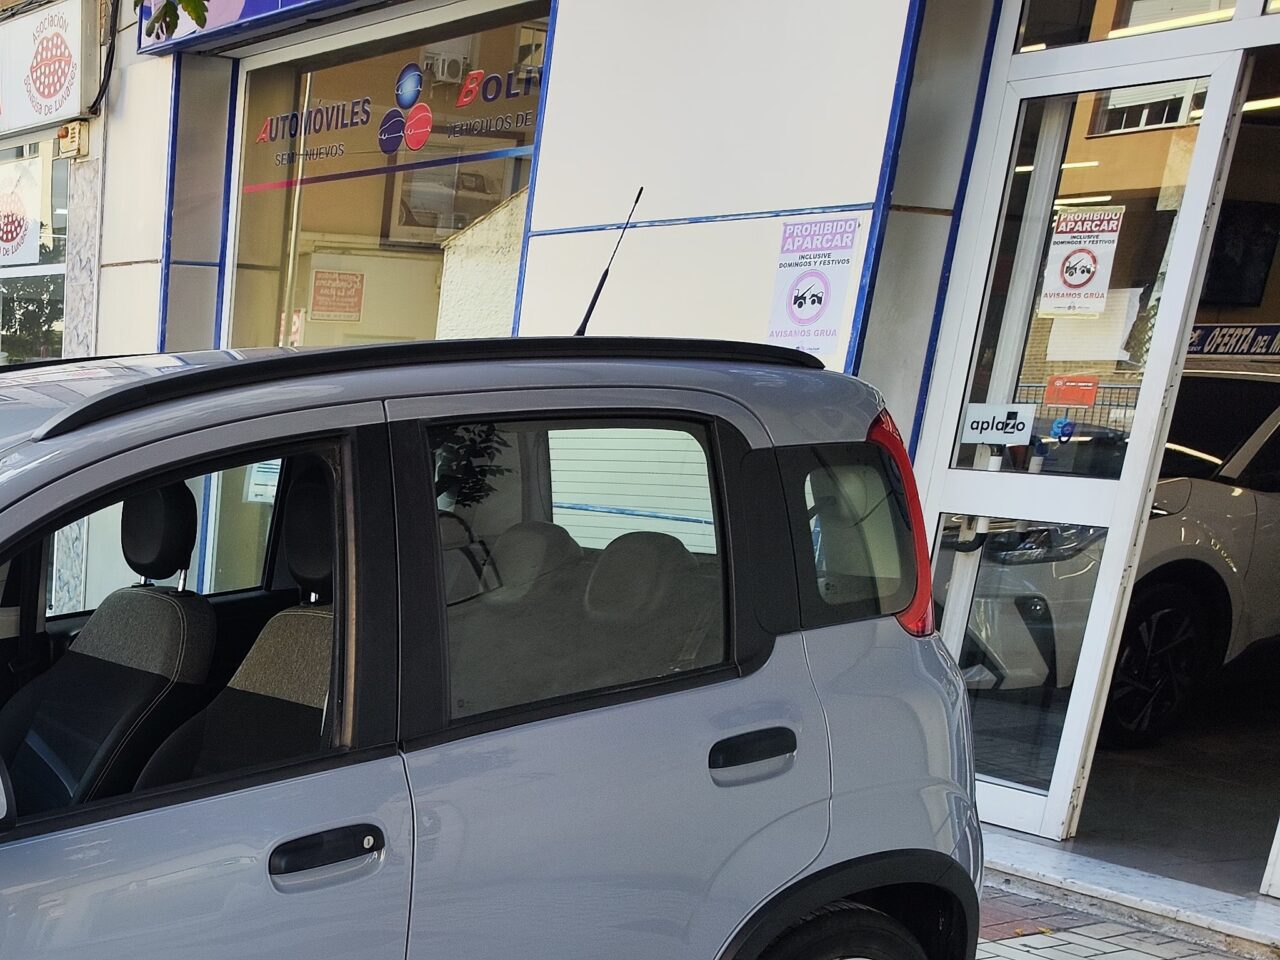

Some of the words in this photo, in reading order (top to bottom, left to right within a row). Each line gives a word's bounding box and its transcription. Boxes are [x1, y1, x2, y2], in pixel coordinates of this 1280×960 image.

[516, 110, 533, 128] DE
[305, 143, 345, 161] NUEVOS
[1060, 212, 1120, 221] PROHIBIDO
[785, 221, 854, 238] PROHIBIDO
[1057, 220, 1118, 232] APARCAR
[783, 233, 853, 251] APARCAR
[798, 252, 832, 260] INCLUSIVE
[819, 258, 850, 266] FESTIVOS
[769, 330, 812, 338] AVISAMOS
[1203, 327, 1257, 353] OFERTA
[1250, 335, 1272, 353] DEL
[970, 412, 1026, 434] aplazo
